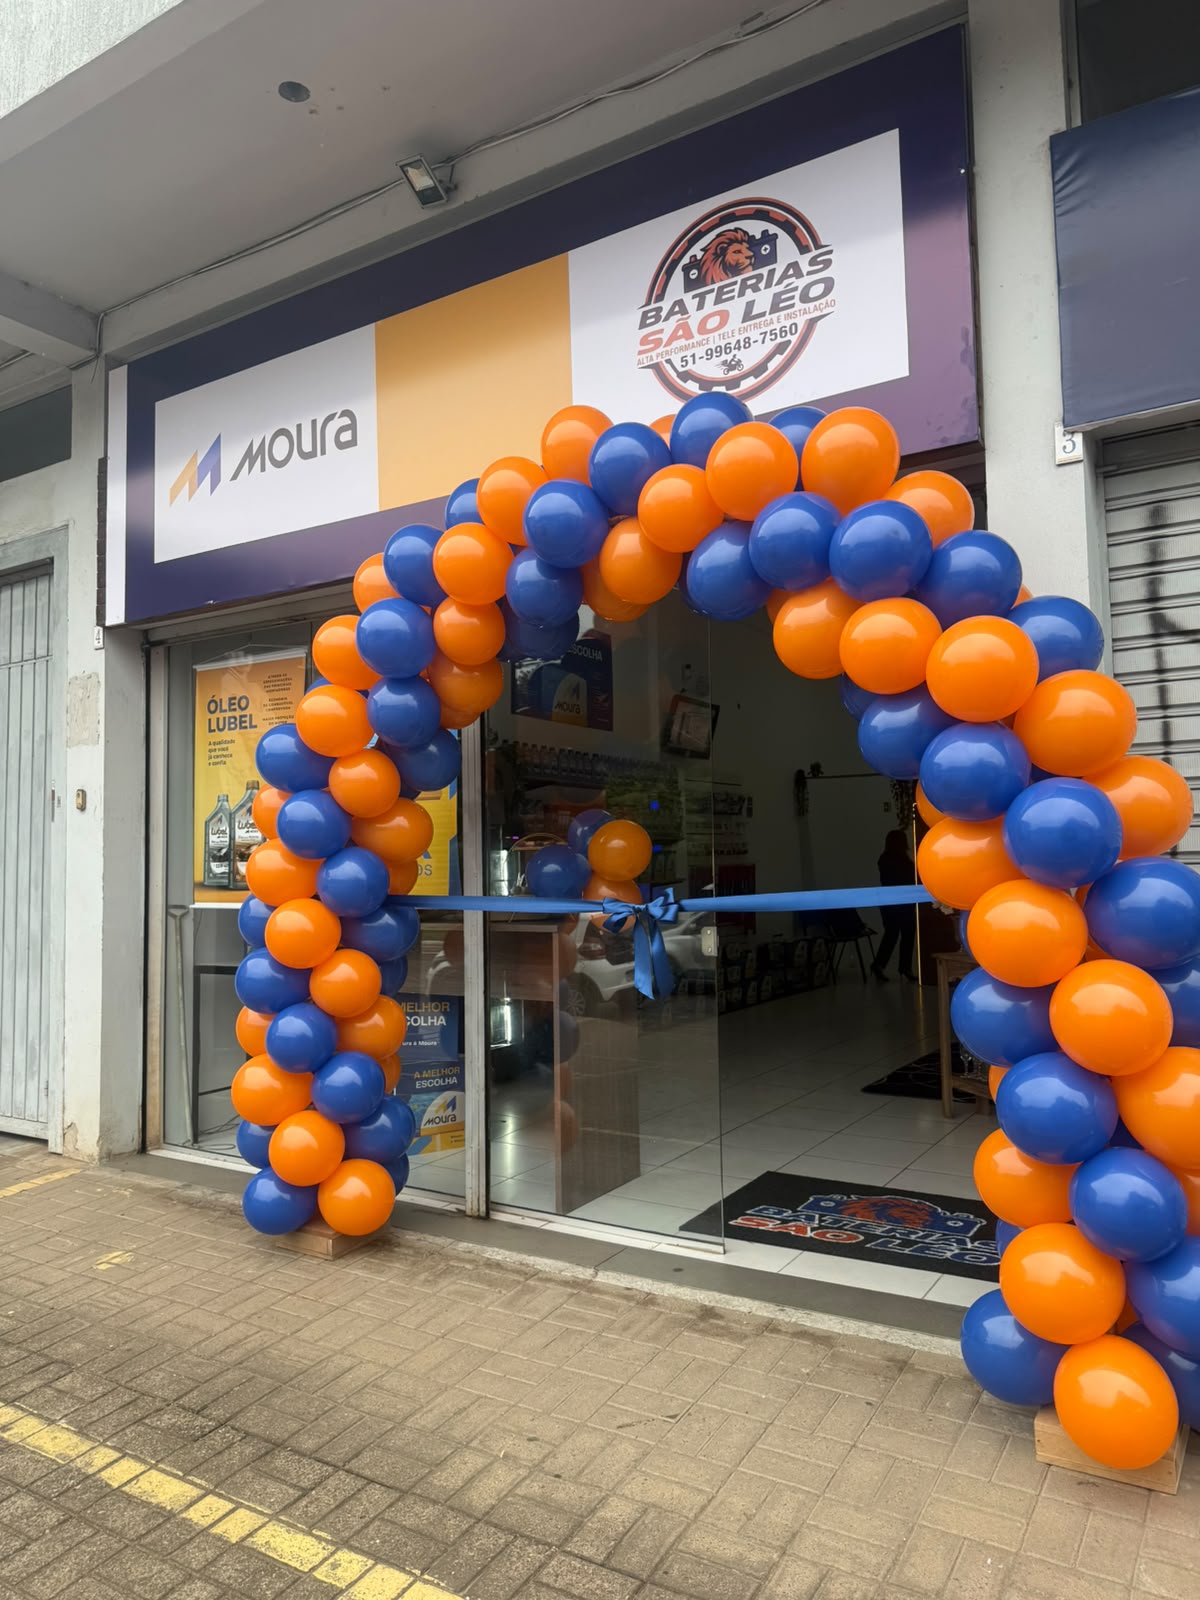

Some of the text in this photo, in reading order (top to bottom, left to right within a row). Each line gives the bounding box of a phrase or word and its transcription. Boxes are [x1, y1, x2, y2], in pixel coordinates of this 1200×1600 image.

[638, 249, 833, 330] BATERIAS
[637, 277, 835, 356] SÃO LÉO
[637, 355, 654, 366] ALTA
[656, 337, 710, 359] PERFORMANCE
[718, 330, 736, 341] TELE
[738, 318, 774, 335] ENTREGA
[776, 315, 782, 324] E
[783, 299, 836, 321] INSTALAÇÃO
[680, 322, 798, 368] 51-99648-7560
[1062, 431, 1076, 454] 3
[207, 695, 250, 715] ÓLEO
[207, 713, 257, 733] LUBEL
[238, 820, 258, 830] Lube
[414, 1066, 460, 1079] A MELHOR
[416, 1076, 458, 1089] ESCOLHA
